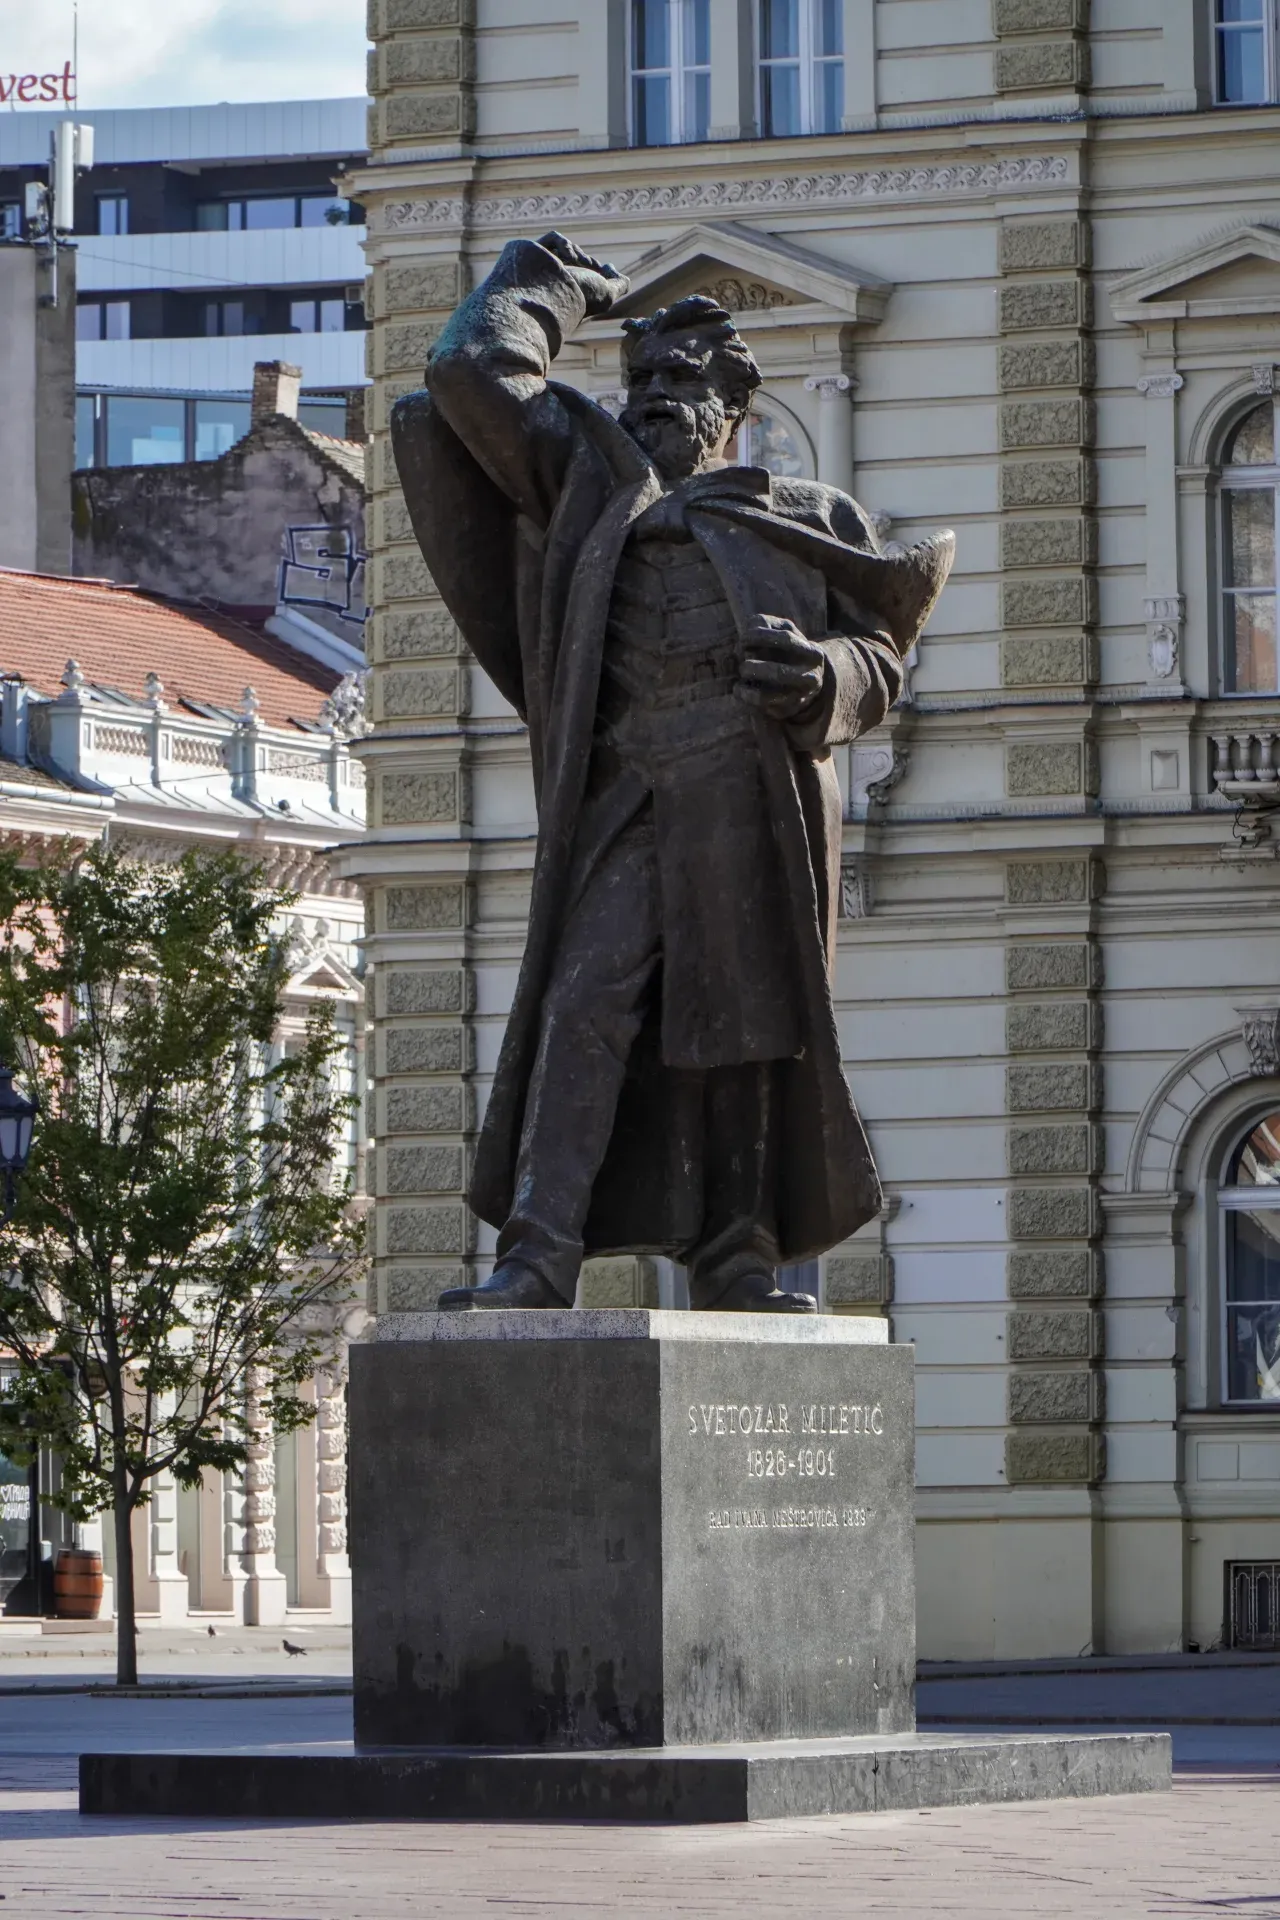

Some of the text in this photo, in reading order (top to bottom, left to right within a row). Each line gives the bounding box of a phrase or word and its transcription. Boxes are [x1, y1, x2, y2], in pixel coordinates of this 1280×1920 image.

[688, 1402, 884, 1435] SVETOZAR MILETIĆ
[747, 1449, 836, 1477] 1826-1901
[709, 1510, 731, 1528] RAD
[734, 1509, 768, 1528] IVANA
